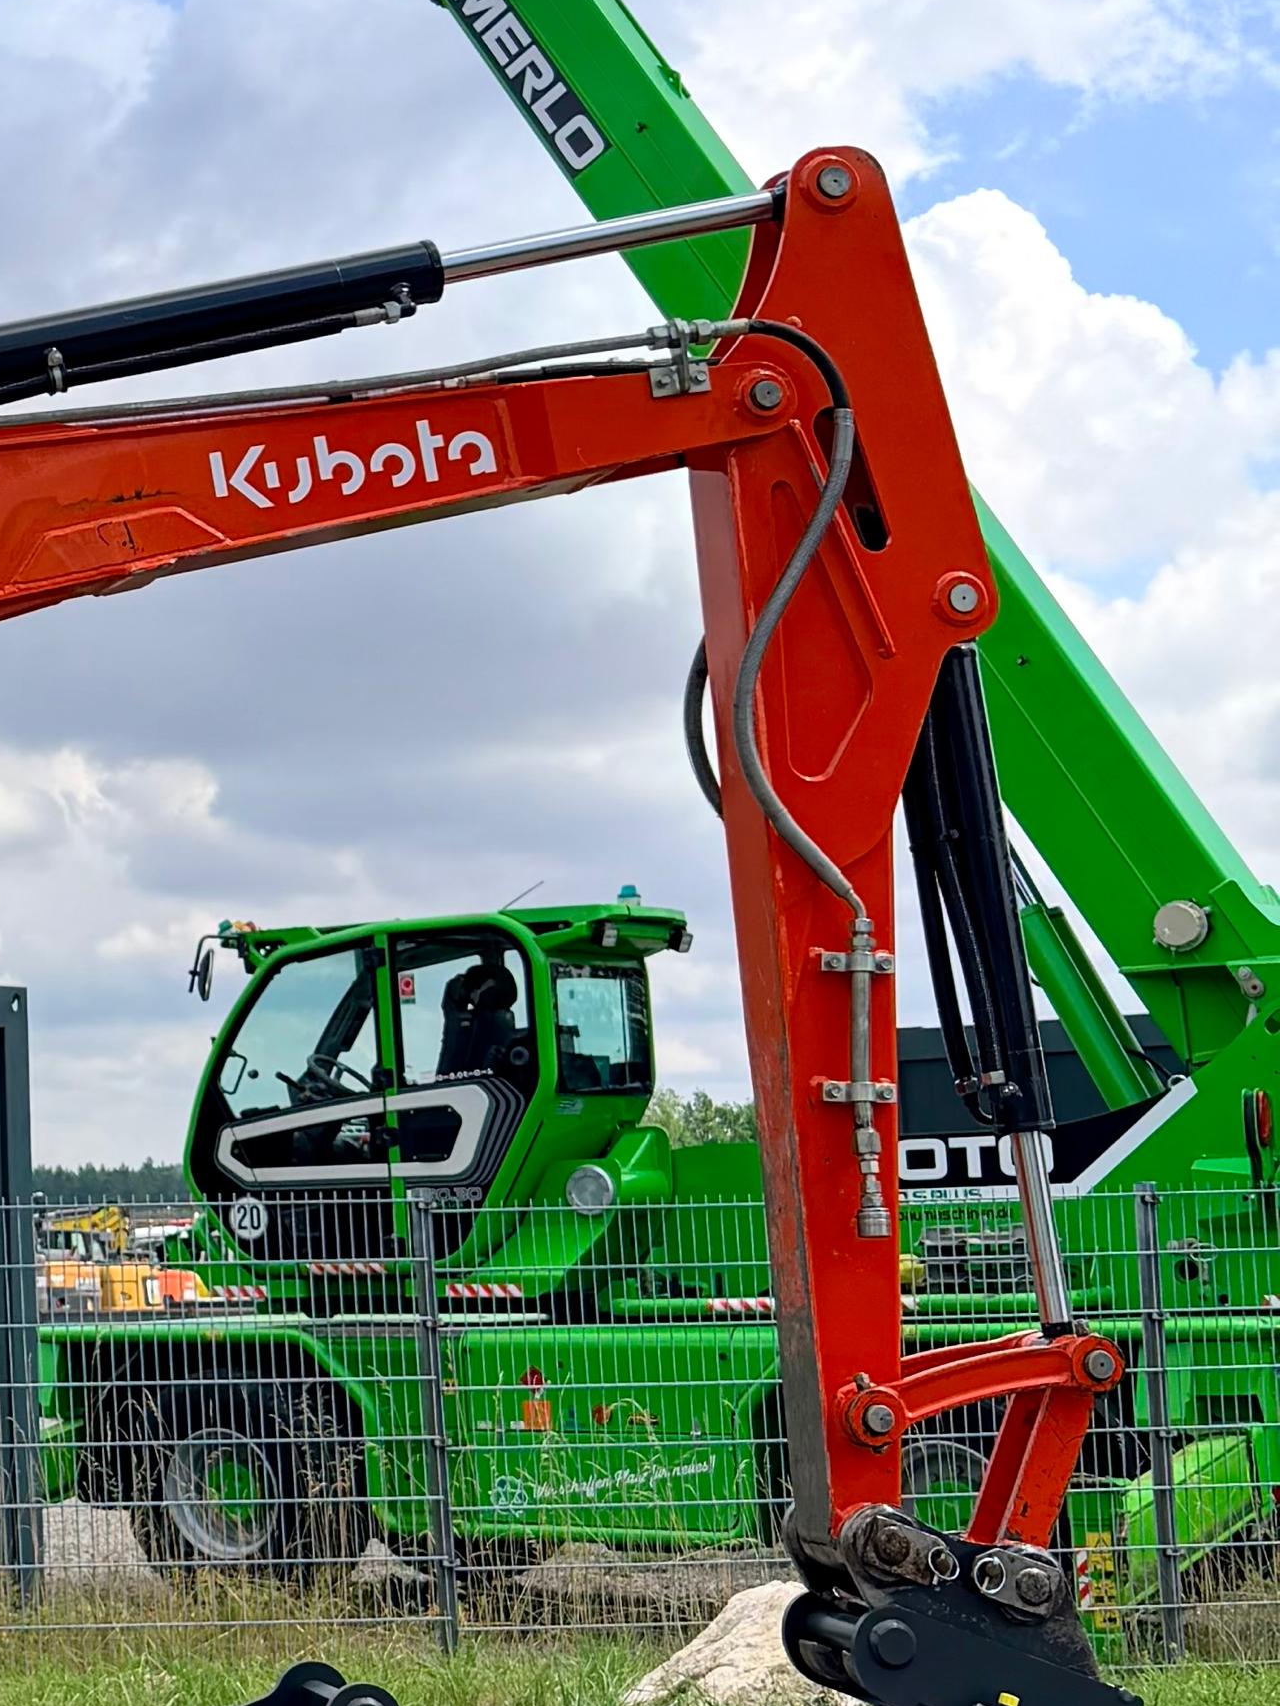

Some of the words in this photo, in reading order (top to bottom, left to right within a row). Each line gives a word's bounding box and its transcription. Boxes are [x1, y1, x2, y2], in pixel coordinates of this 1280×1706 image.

[208, 420, 497, 508] Kubota
[898, 1133, 1054, 1181] OTO
[237, 1205, 261, 1230] 20
